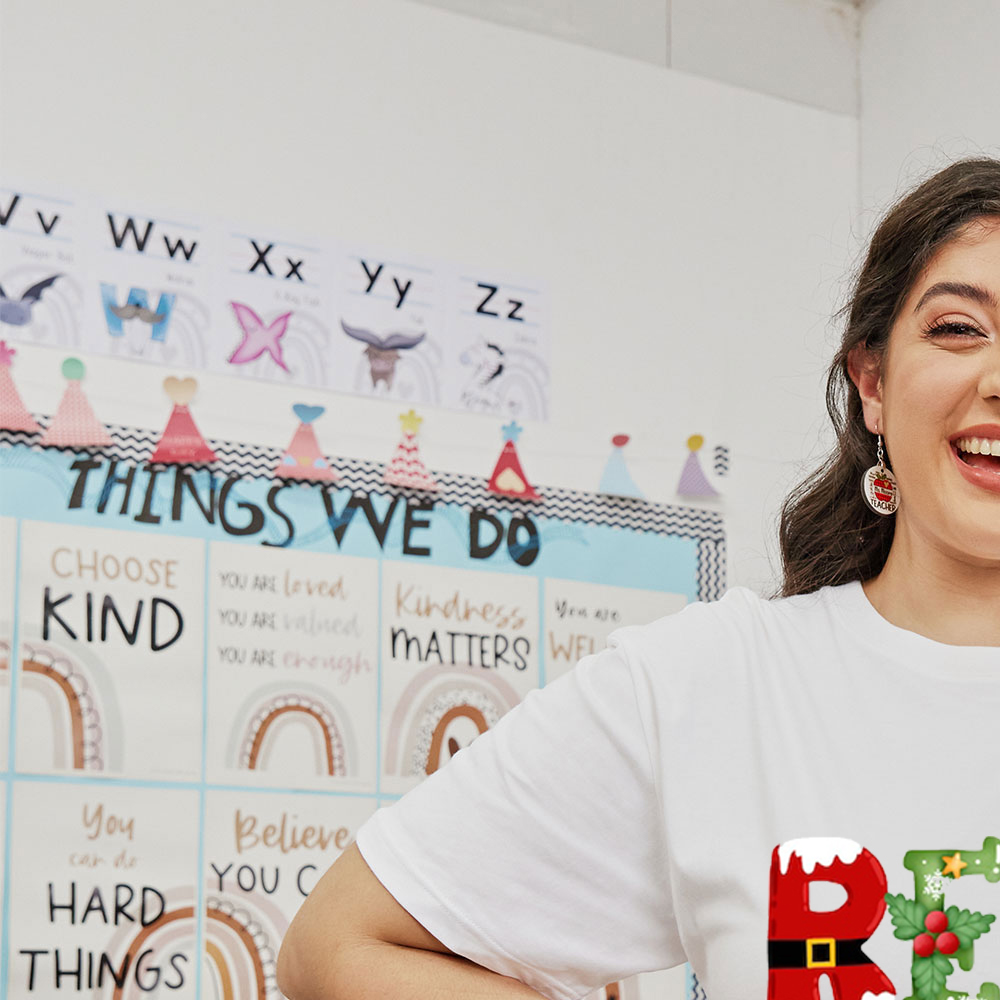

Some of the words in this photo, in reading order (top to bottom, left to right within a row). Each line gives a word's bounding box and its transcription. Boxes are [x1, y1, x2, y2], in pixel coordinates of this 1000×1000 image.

[68, 460, 294, 548] THINGS
[321, 486, 434, 557] WE
[469, 506, 541, 567] DO
[51, 548, 178, 589] CHOOSE
[219, 571, 248, 590] YOU
[252, 575, 276, 593] ARE
[284, 568, 347, 601] loved
[43, 587, 183, 651] KIND
[218, 608, 247, 627] YOU
[252, 612, 276, 631] ARE
[395, 582, 527, 631] Kindness
[218, 646, 247, 664] YOU
[252, 650, 275, 668] ARE
[283, 651, 373, 685] enough
[83, 803, 134, 841] You
[235, 809, 354, 854] Believe
[69, 852, 105, 868] can
[114, 849, 138, 869] do
[211, 863, 279, 895] YOU
[48, 881, 165, 927] HARD
[19, 948, 188, 992] THINGS
